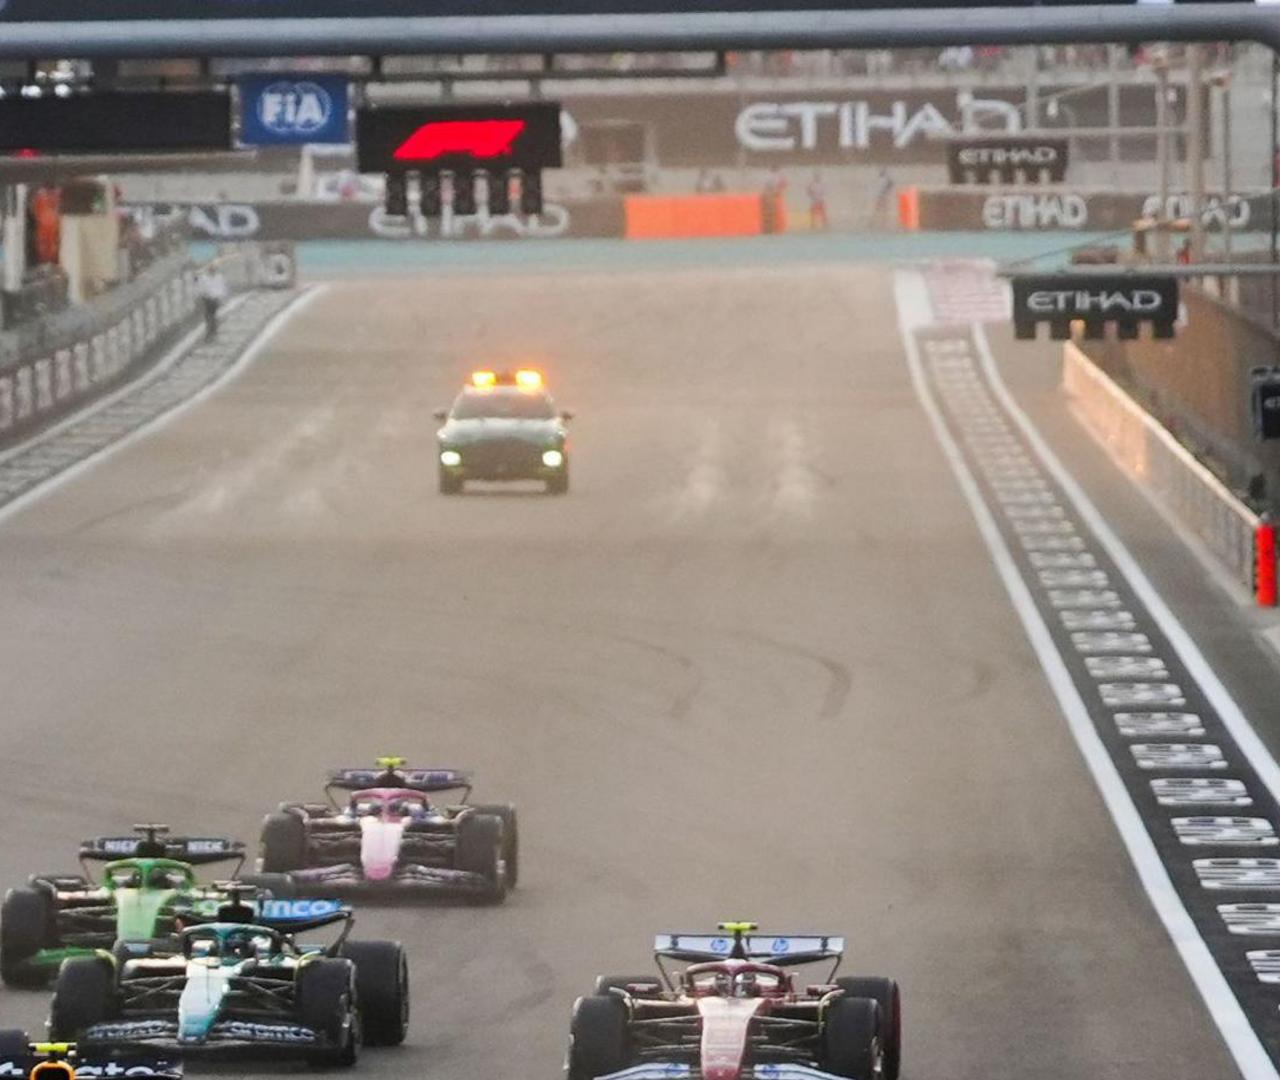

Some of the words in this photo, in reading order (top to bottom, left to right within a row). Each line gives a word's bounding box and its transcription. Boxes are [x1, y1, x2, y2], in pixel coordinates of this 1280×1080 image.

[261, 93, 322, 125] FIA
[735, 100, 1022, 150] ETIHAD
[959, 147, 1057, 165] ETIHAD
[1027, 290, 1162, 313] ETIHAD
